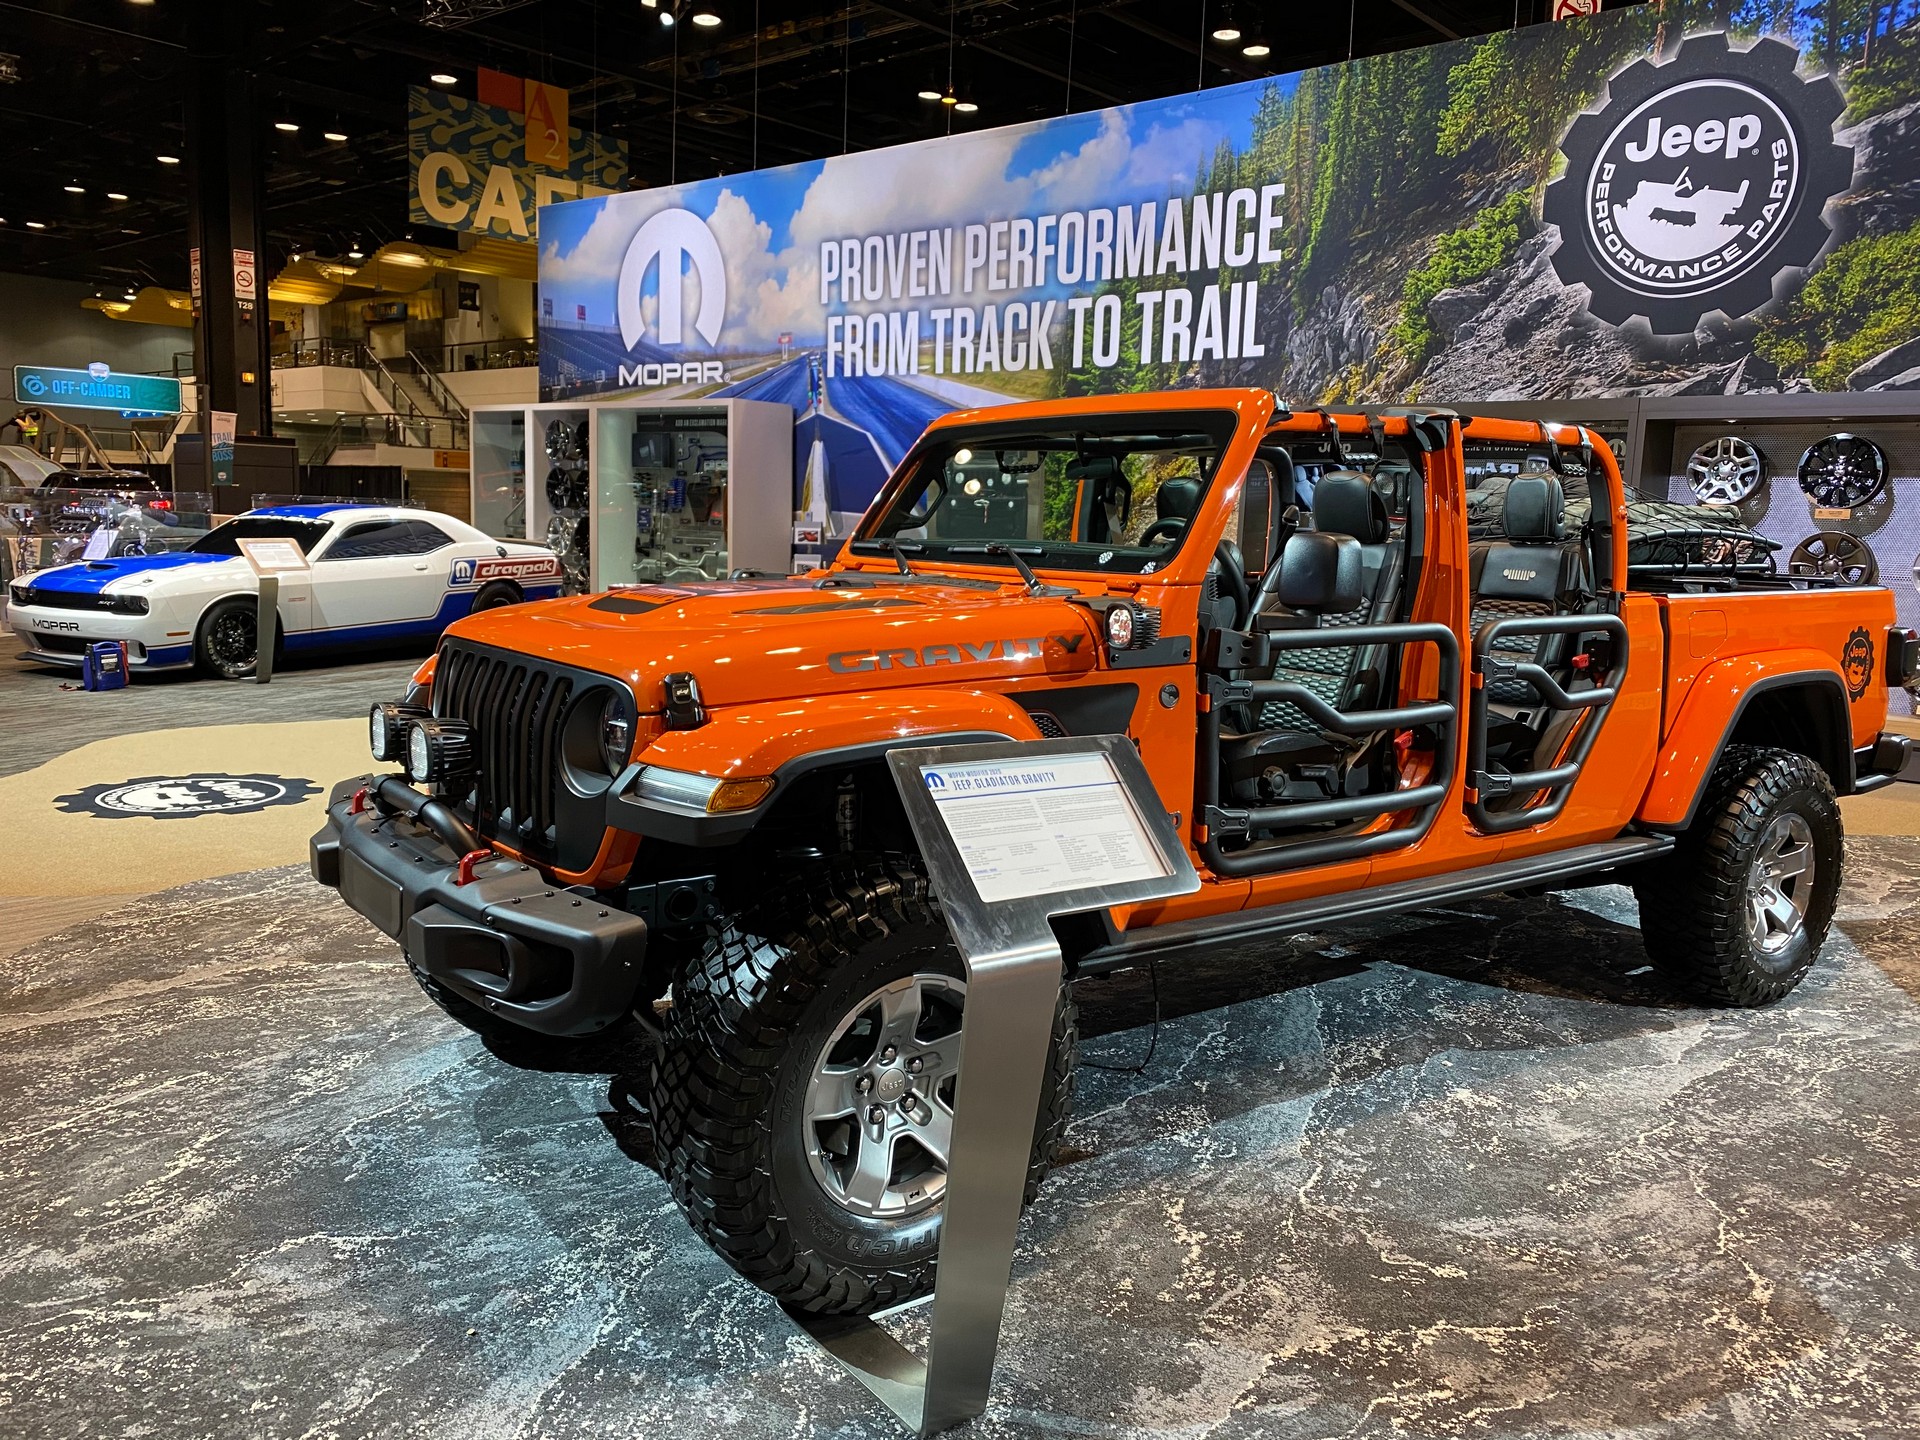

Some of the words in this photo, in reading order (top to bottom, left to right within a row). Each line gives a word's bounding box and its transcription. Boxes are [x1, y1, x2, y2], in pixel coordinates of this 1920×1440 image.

[1625, 114, 1762, 162] Jeep
[418, 151, 619, 239] CAF
[1595, 161, 1743, 280] PERFORMANCE
[1746, 138, 1789, 241] PARTS
[820, 227, 953, 304] PROVEN
[964, 183, 1286, 293] PERFORMANCE
[237, 301, 253, 310] T28
[826, 310, 919, 379] FROM
[930, 300, 1058, 375] TRACK
[1068, 294, 1122, 369] TO
[1135, 280, 1265, 365] TRAIL
[617, 360, 724, 386] MOPAR
[52, 379, 131, 400] OFF-CAMBER
[212, 432, 233, 444] TRAIL
[212, 450, 234, 463] BOSS
[481, 560, 553, 578] dragpak
[32, 618, 80, 632] MOPAR
[827, 633, 1086, 674] GRAVITY
[975, 774, 1021, 789] GLADIATOR
[1021, 771, 1056, 785] GRAVITY
